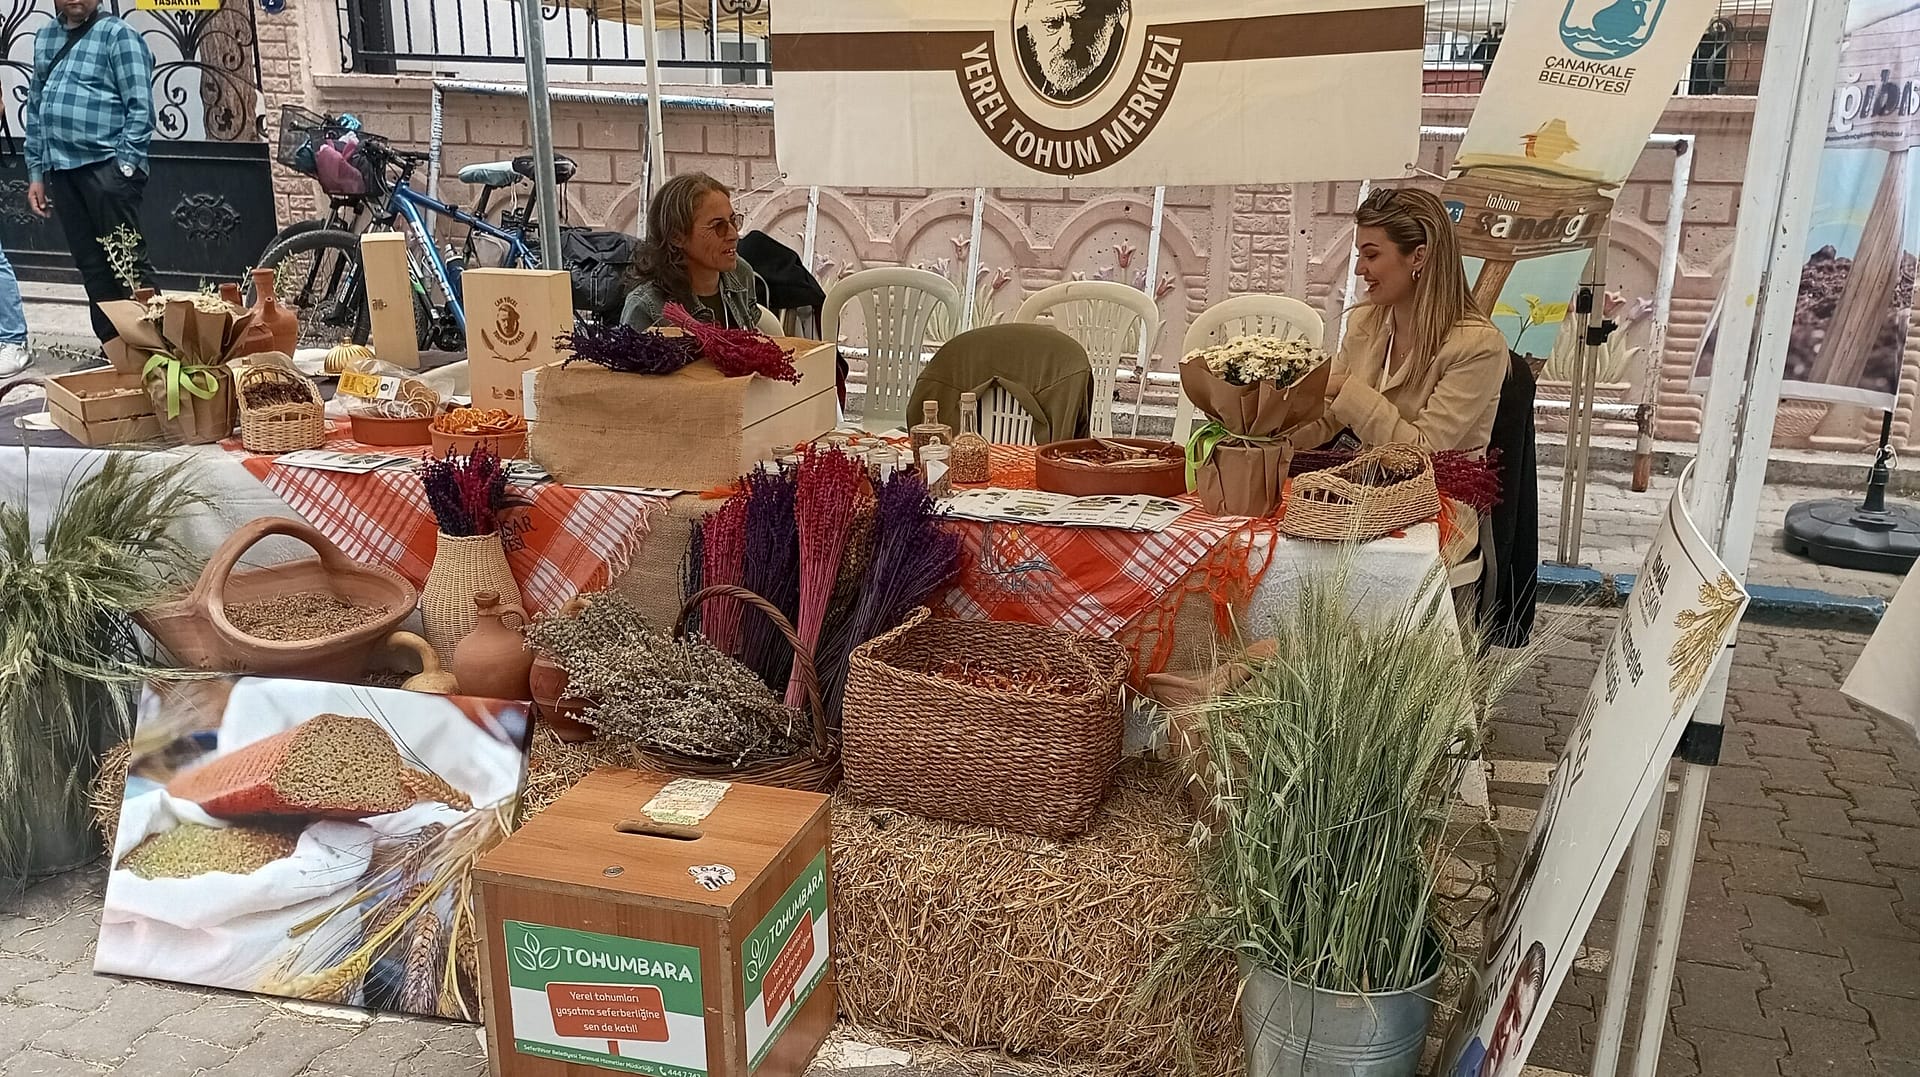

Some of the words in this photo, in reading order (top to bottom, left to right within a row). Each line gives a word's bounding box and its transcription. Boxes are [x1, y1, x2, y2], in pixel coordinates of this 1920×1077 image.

[1544, 56, 1637, 79] ÇANAKKALE
[1539, 70, 1631, 94] BELEDİYESİ
[961, 41, 1008, 130] YEREL
[1001, 118, 1101, 169] TOHUM
[1100, 34, 1183, 155] MERKEZİ
[1486, 193, 1520, 212] tohum
[1473, 207, 1600, 243] sandığı
[769, 868, 824, 944] TOHUMBARA
[561, 946, 694, 984] TOHUMBARA
[569, 991, 594, 1001] Yerel
[595, 991, 639, 1002] tohumları
[556, 1007, 595, 1018] yaşatma
[597, 1008, 661, 1020] seferberliğine
[583, 1024, 600, 1032] sen
[601, 1023, 613, 1032] de
[614, 1023, 639, 1033] katıl!
